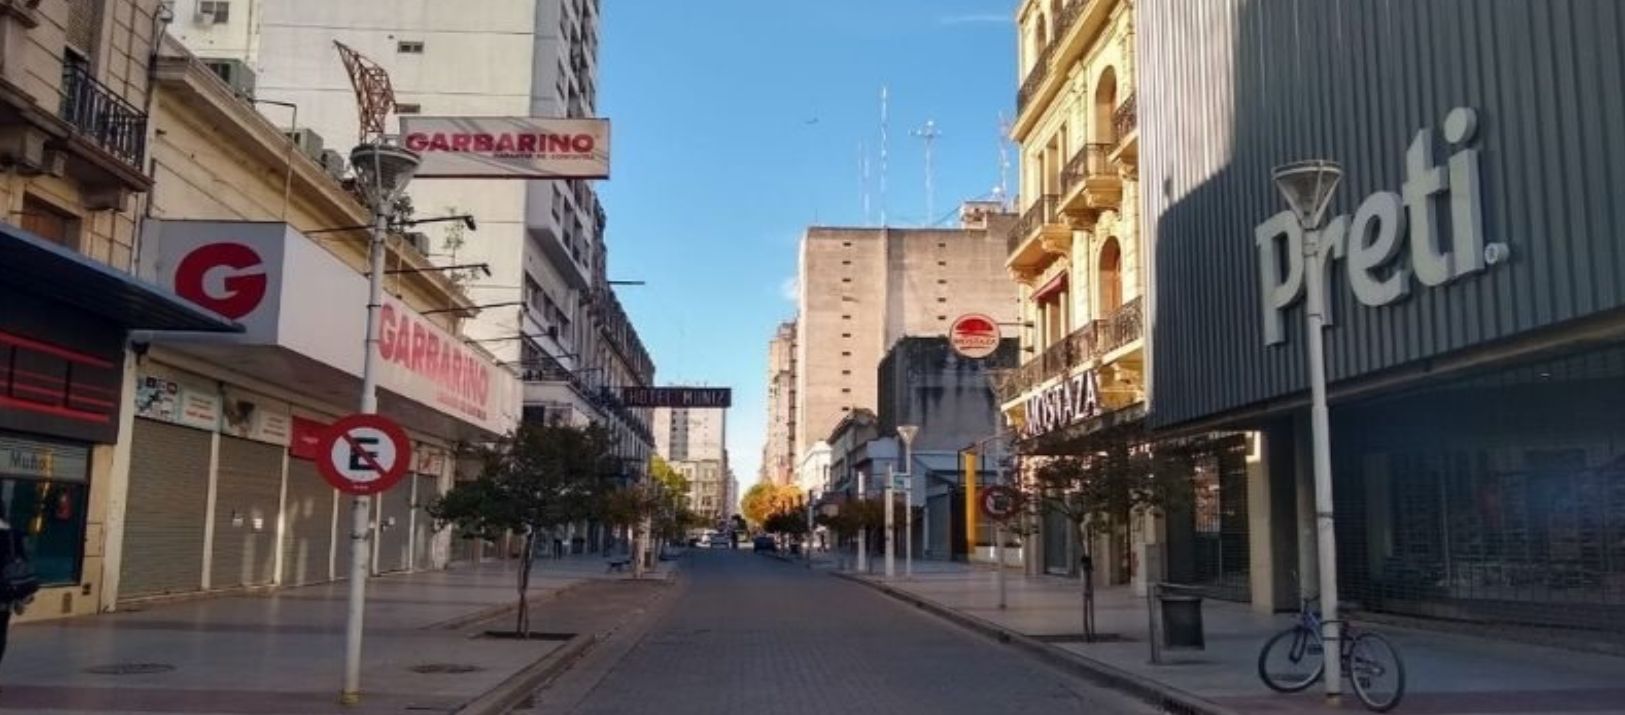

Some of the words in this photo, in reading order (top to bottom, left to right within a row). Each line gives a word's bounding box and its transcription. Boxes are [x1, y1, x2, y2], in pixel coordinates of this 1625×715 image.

[405, 132, 595, 153] GARBARINO
[174, 242, 267, 320] G
[379, 303, 488, 406] GARBARINO
[629, 390, 673, 405] HOTEL
[1023, 368, 1099, 438] MOSTAZA
[350, 437, 379, 470] E
